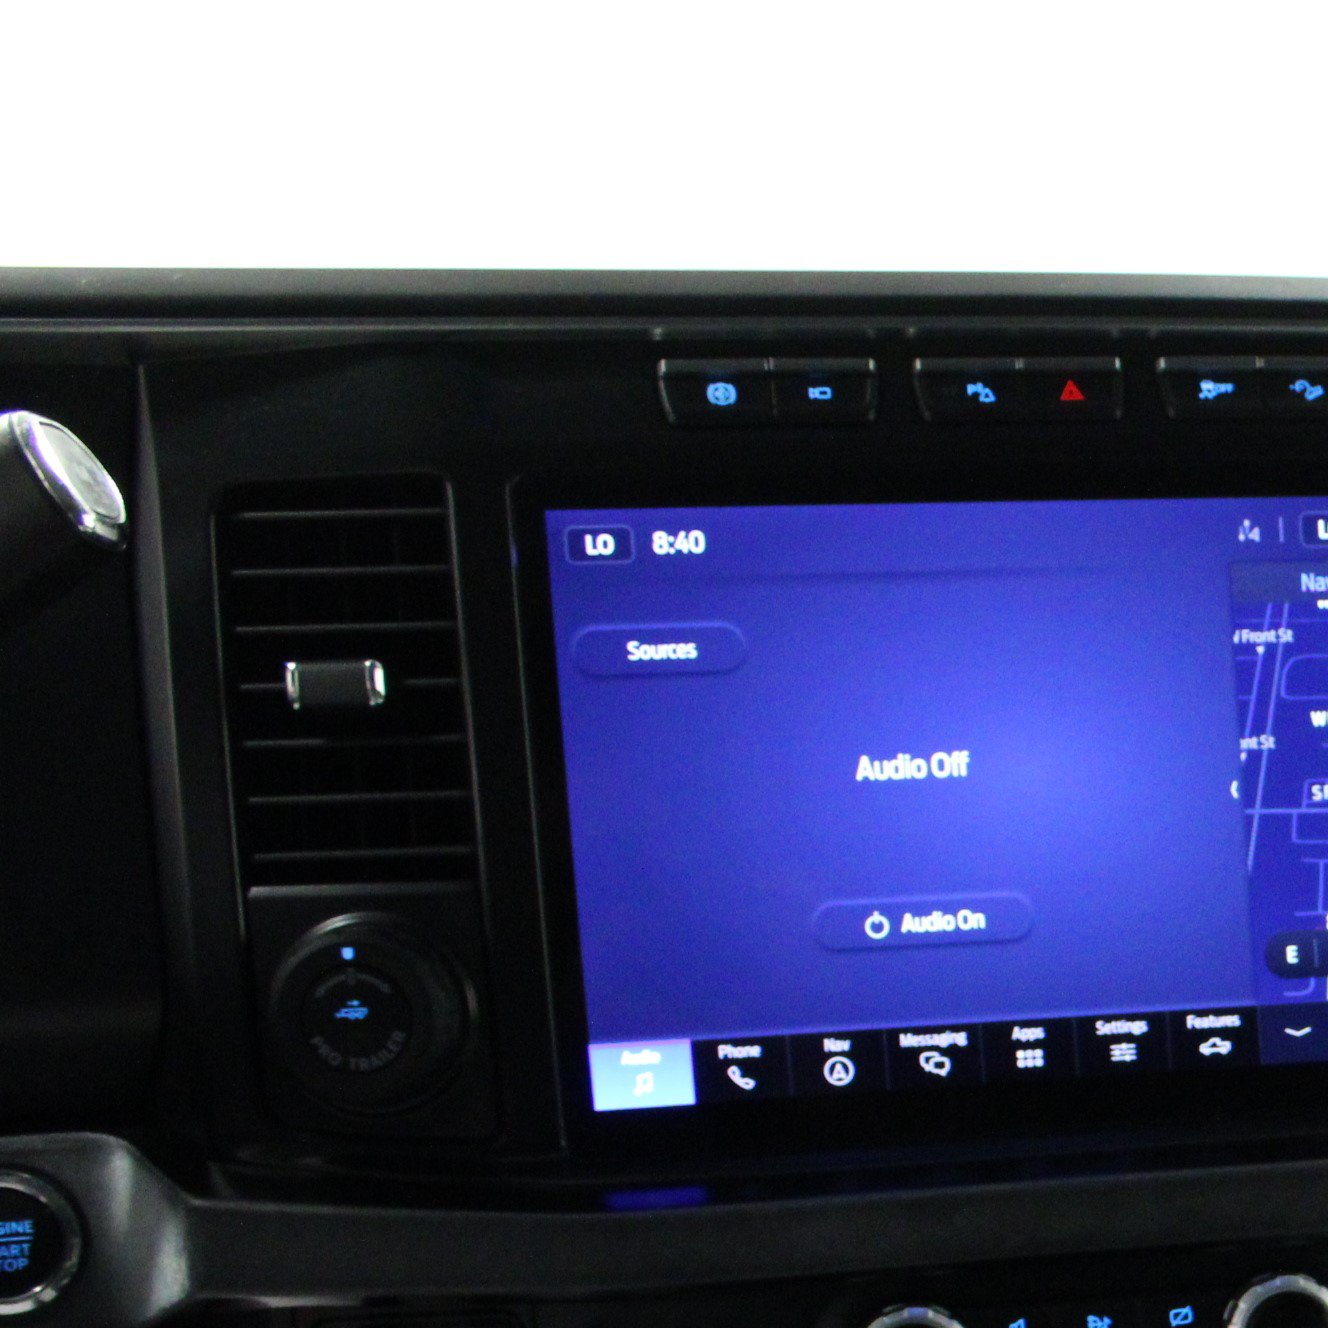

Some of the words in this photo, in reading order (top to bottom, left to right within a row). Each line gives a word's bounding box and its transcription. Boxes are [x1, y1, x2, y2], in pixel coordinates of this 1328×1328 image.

[584, 533, 615, 556] LO
[651, 529, 706, 555] 8:40
[1241, 629, 1276, 644] Front
[1278, 628, 1294, 643] St
[626, 640, 698, 661] Sources
[1310, 710, 1326, 727] W
[855, 753, 928, 782] Audio
[930, 750, 971, 778] Off
[1311, 784, 1322, 801] S
[900, 910, 955, 934] Audio
[957, 908, 986, 930] On
[1285, 944, 1299, 965] E
[1095, 1018, 1148, 1036] Settings
[1186, 1013, 1240, 1030] Features
[1011, 1025, 1045, 1042] Apps
[717, 1044, 762, 1060] Phone
[823, 1037, 851, 1053] Nav
